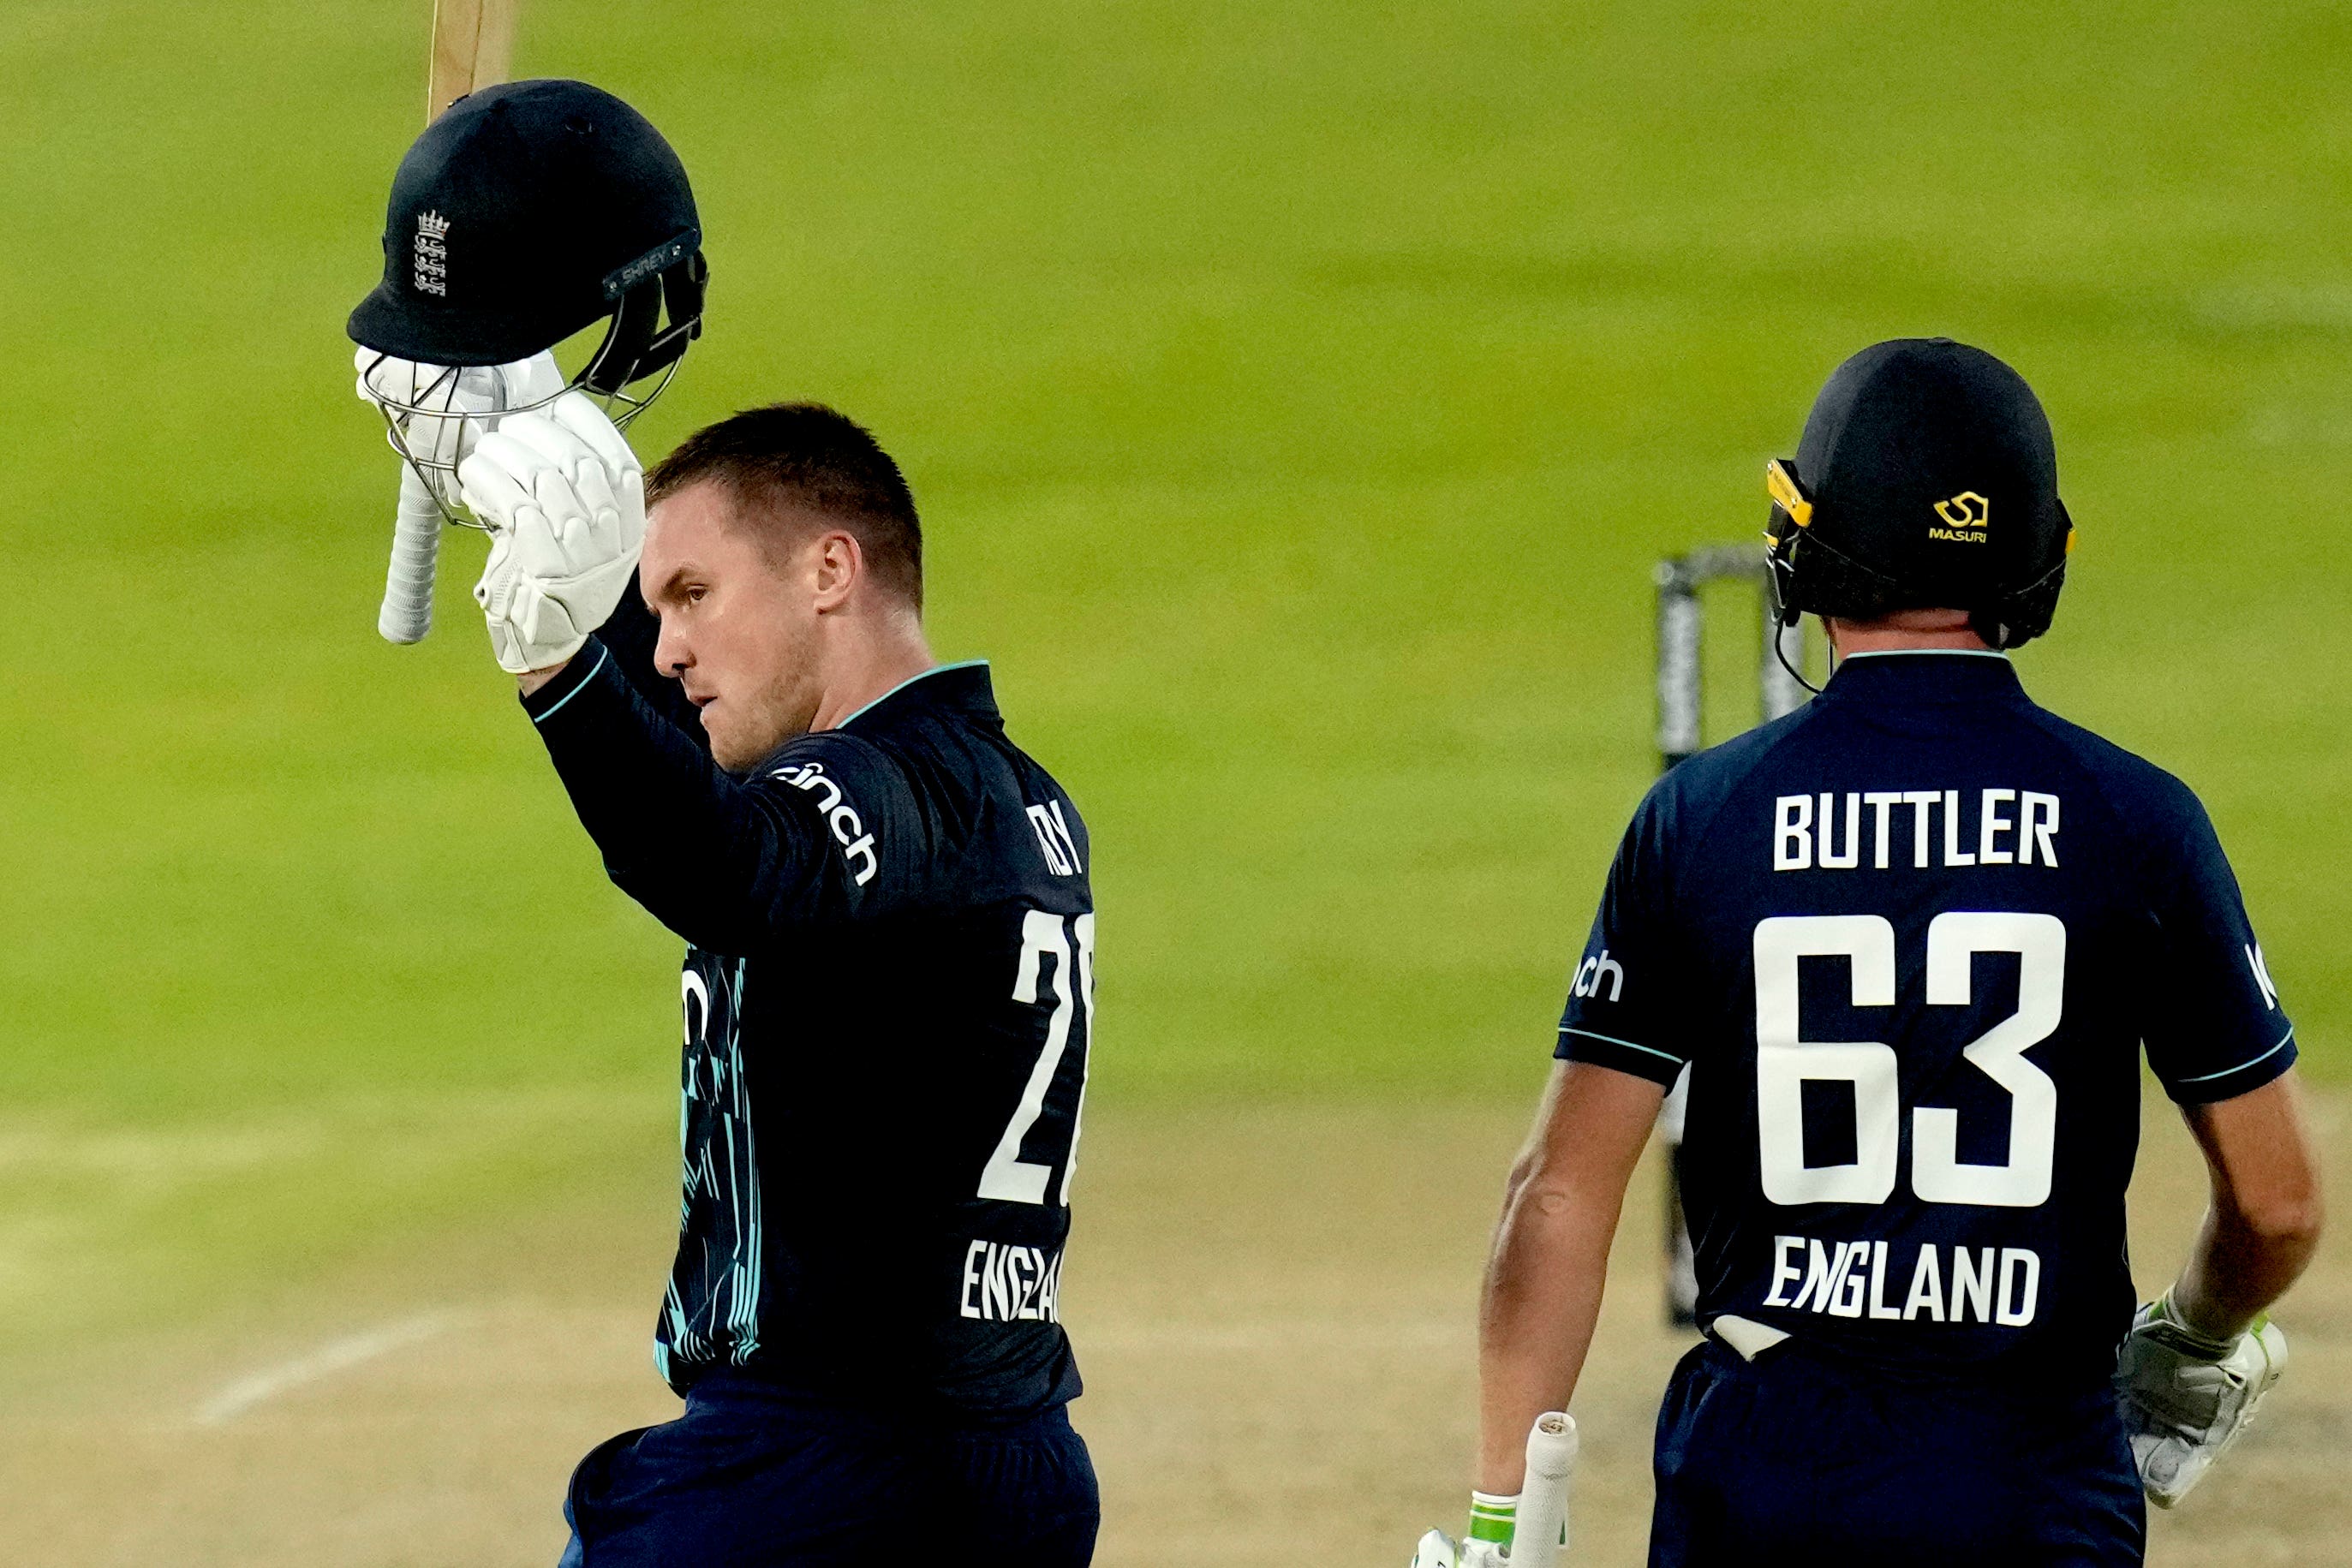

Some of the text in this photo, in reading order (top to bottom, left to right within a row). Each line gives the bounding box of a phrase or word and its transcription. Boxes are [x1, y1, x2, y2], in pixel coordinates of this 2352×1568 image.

[1929, 528, 1987, 543] MASURI
[767, 762, 877, 887] cinch
[1773, 788, 2060, 872] BUTTLER
[1568, 949, 1624, 1002] ch
[1752, 911, 2067, 1207] 63
[1762, 1235, 2040, 1327] ENGLAND
